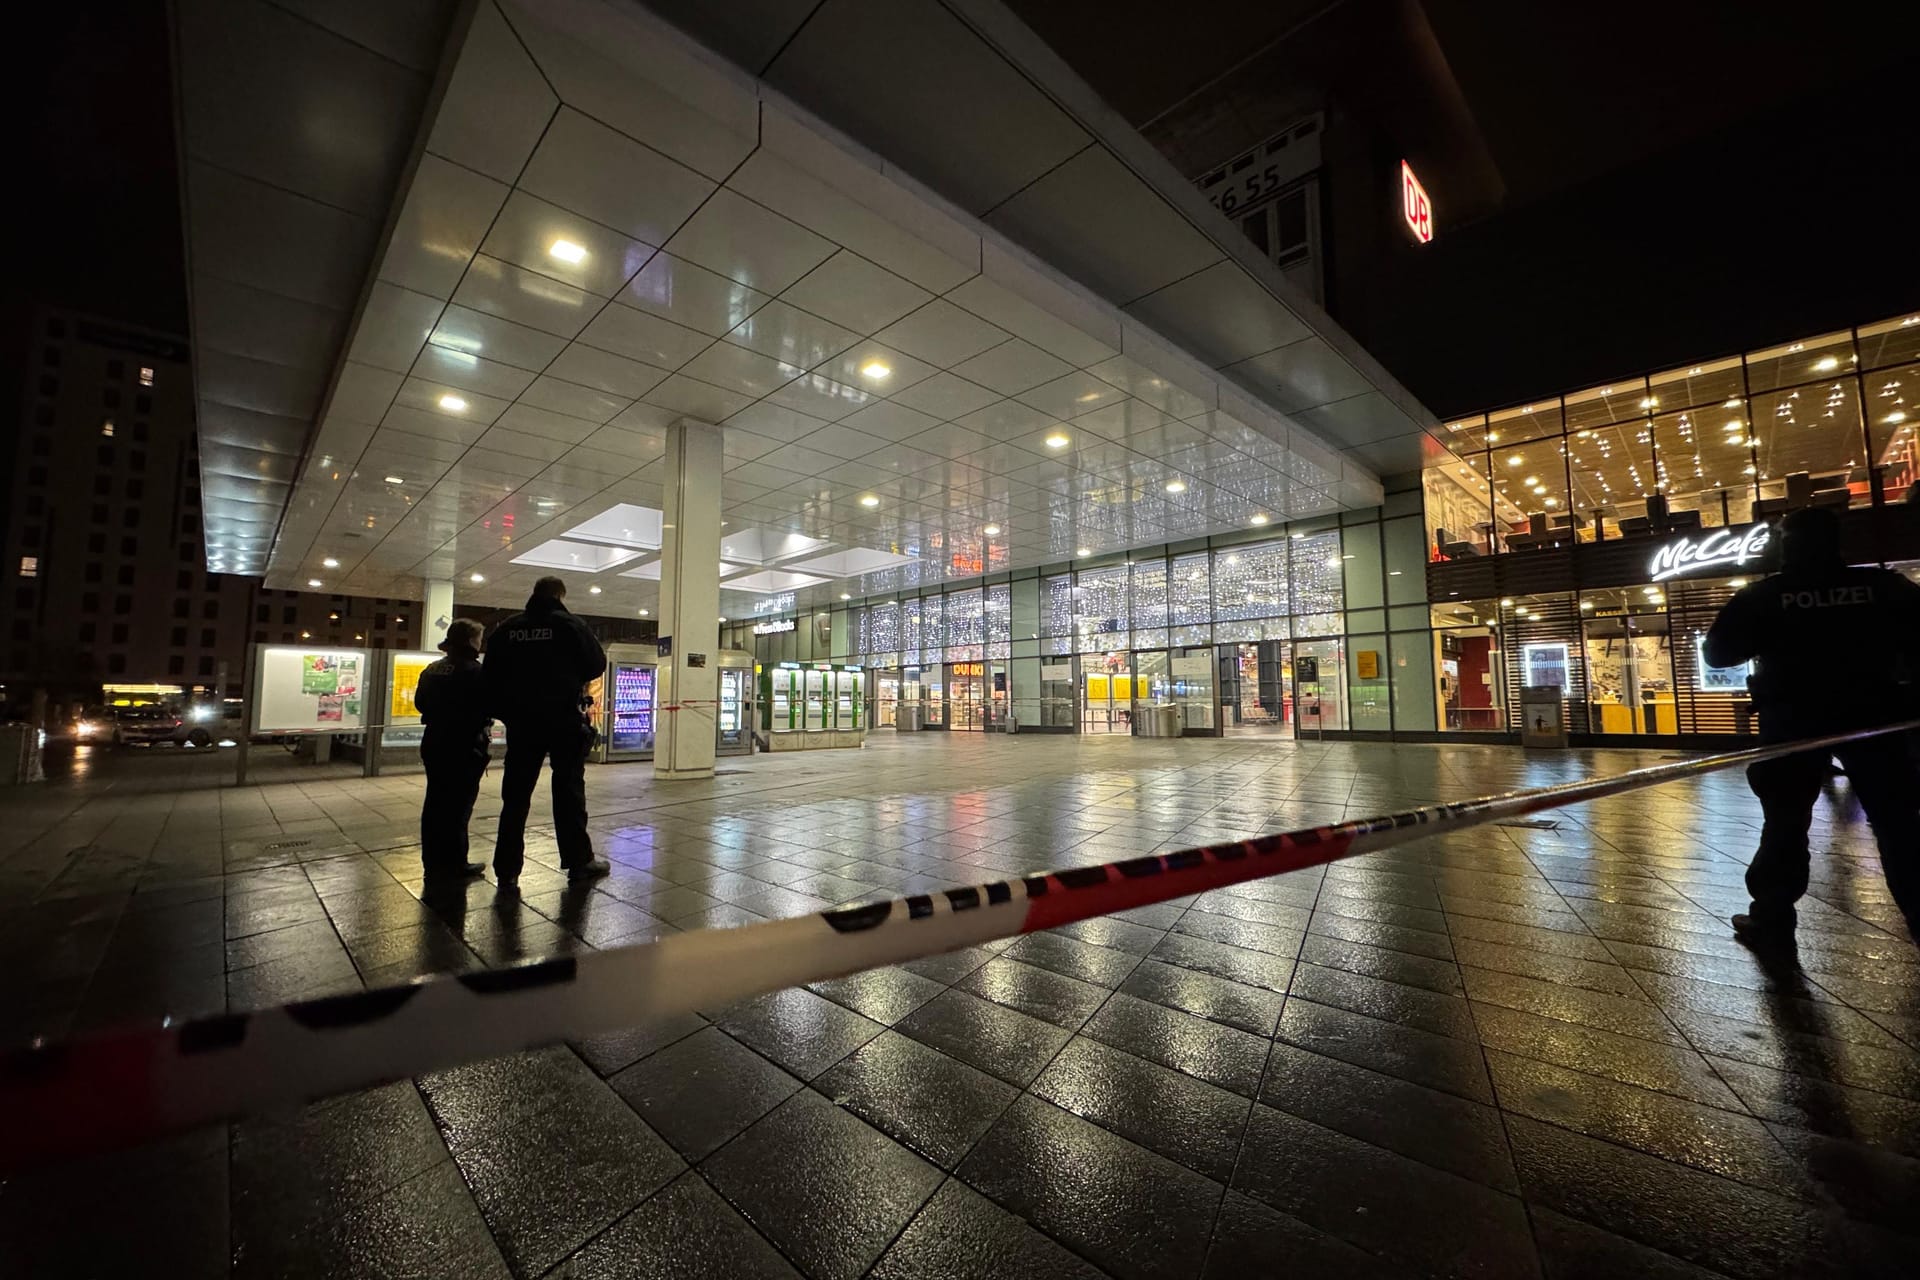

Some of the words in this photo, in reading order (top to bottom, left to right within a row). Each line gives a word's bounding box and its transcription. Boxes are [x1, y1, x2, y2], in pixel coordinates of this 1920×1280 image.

[1246, 164, 1279, 201] 55
[1405, 174, 1430, 241] DB
[1650, 522, 1770, 576] McCafé
[1780, 585, 1874, 610] POLIZEI
[509, 628, 553, 642] POLIZEI
